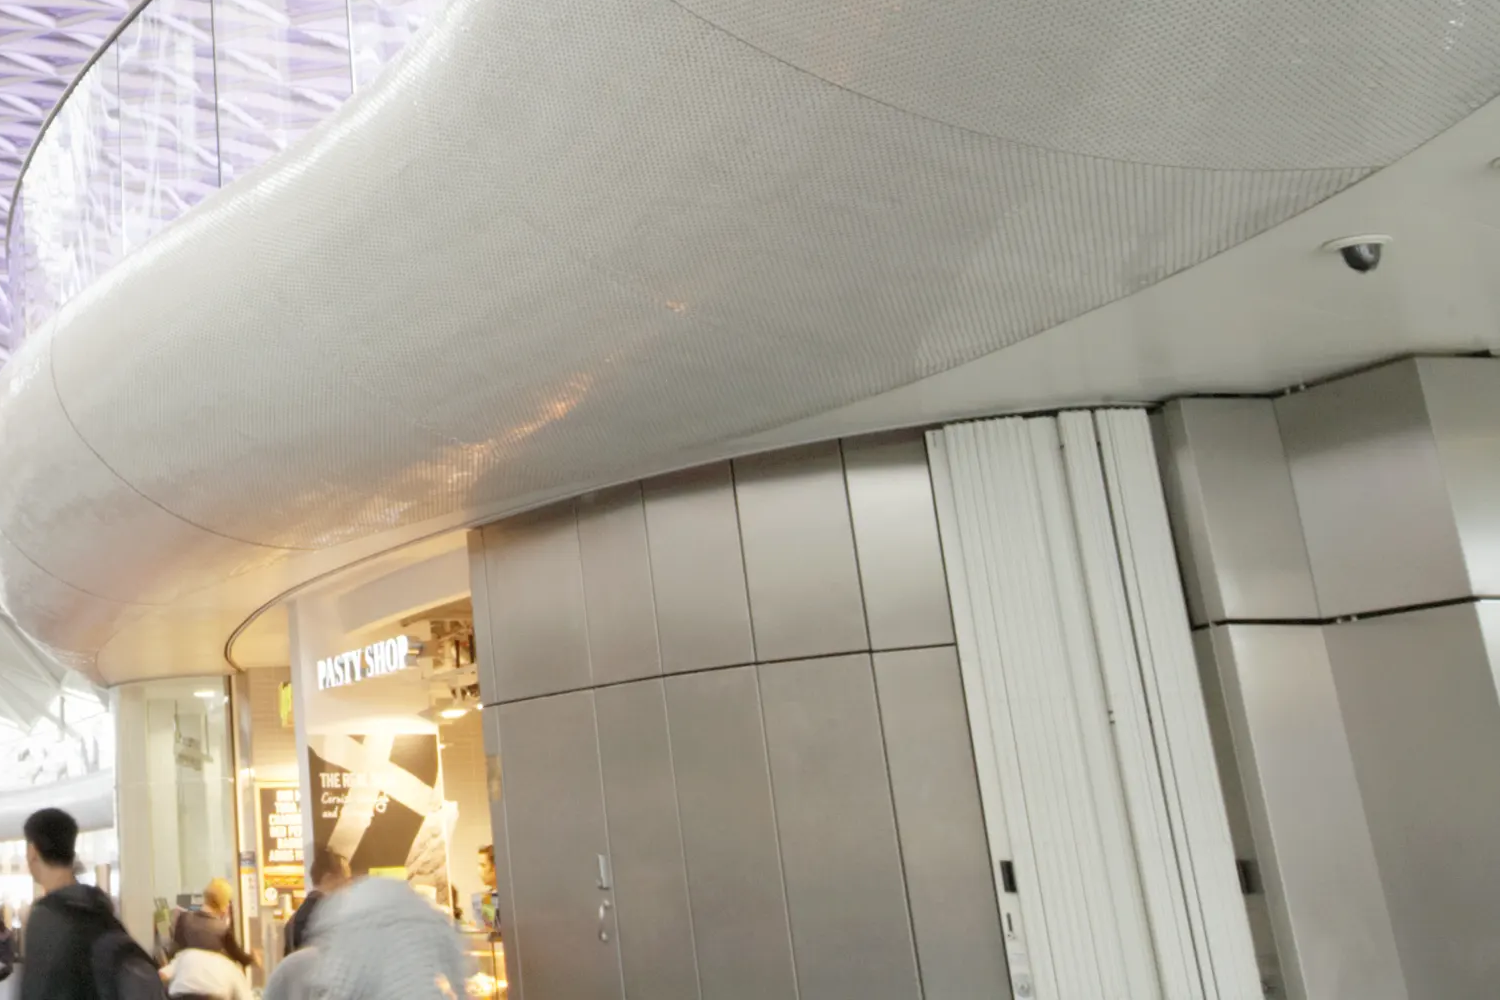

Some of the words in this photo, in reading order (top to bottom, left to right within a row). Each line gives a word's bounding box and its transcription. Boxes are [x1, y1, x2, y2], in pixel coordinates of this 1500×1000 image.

[317, 648, 362, 690] PASTY
[365, 634, 408, 677] SHOP
[320, 772, 341, 788] THE
